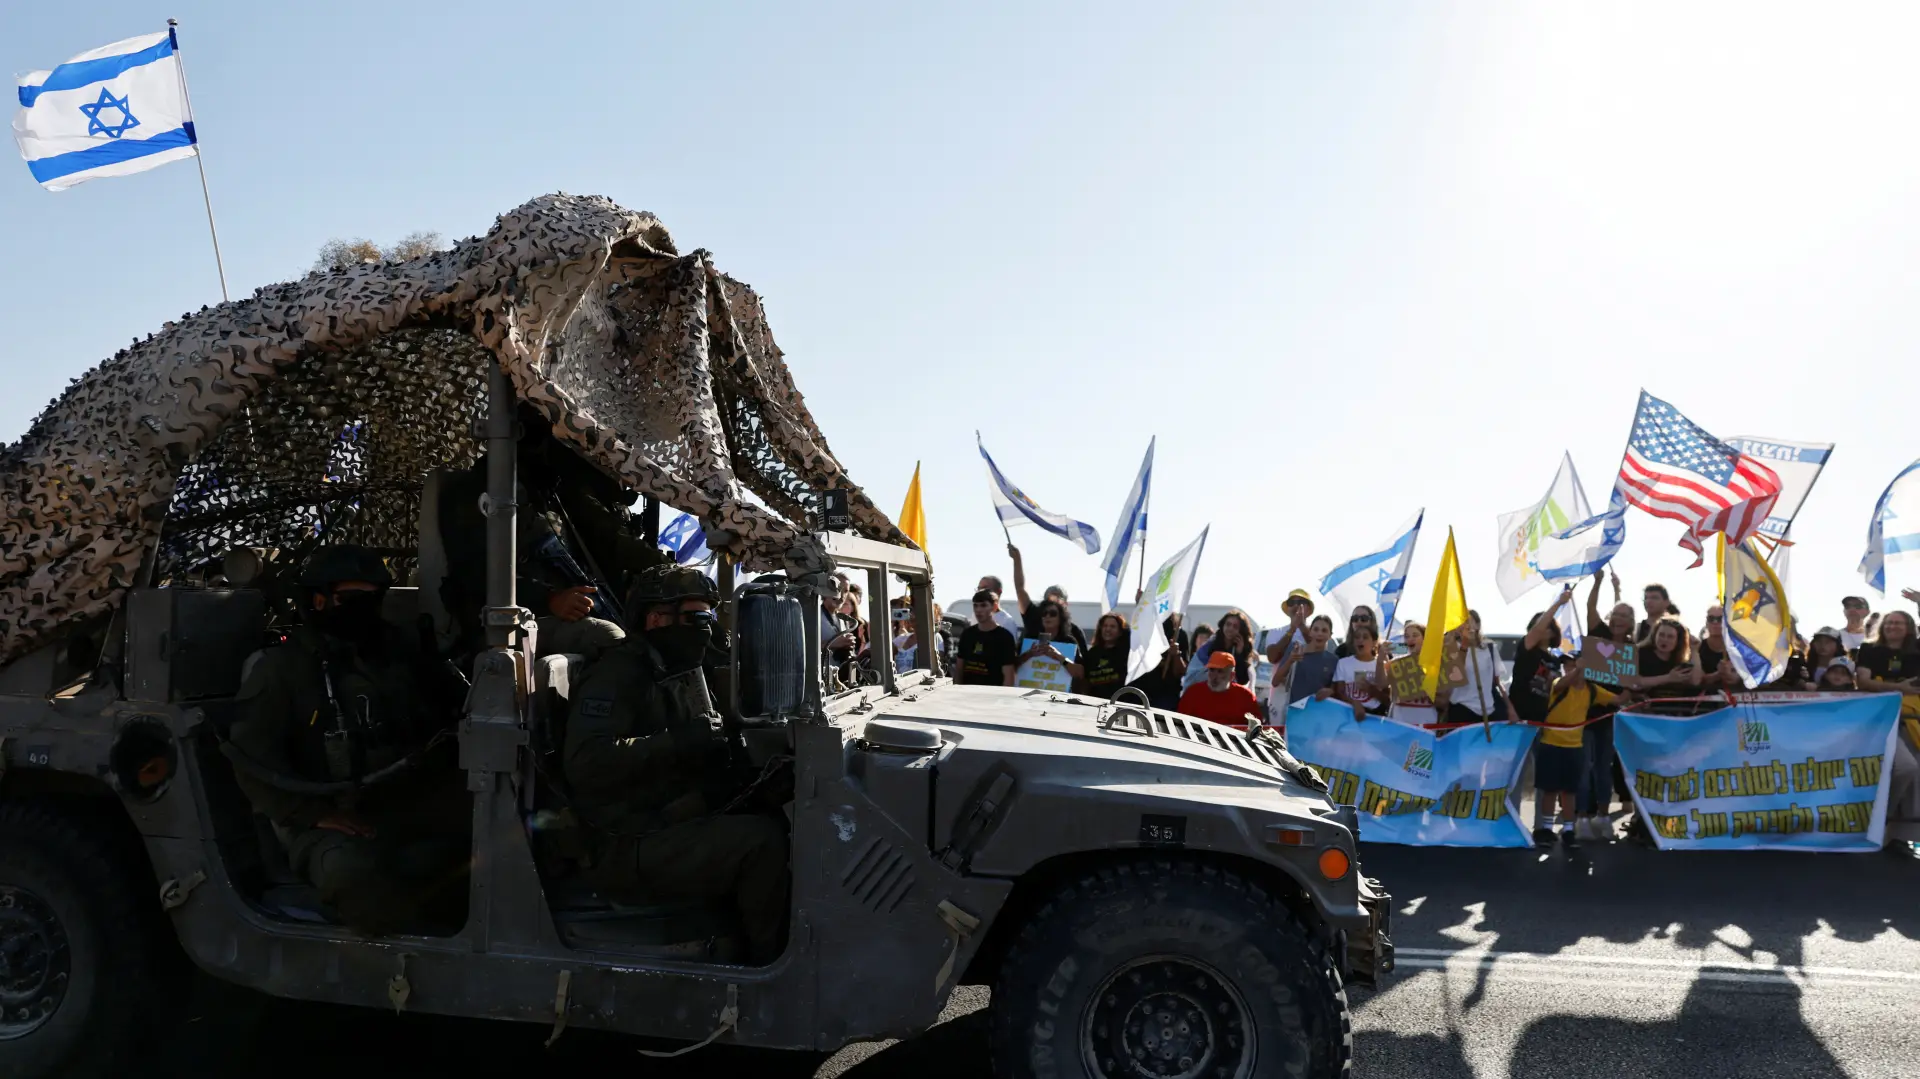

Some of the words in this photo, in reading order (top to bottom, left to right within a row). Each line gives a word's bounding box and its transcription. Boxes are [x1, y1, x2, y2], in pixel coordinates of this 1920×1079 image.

[1606, 660, 1637, 676] חוזר
[29, 752, 48, 765] 40
[1849, 754, 1885, 788] מה
[1690, 808, 1729, 839] של
